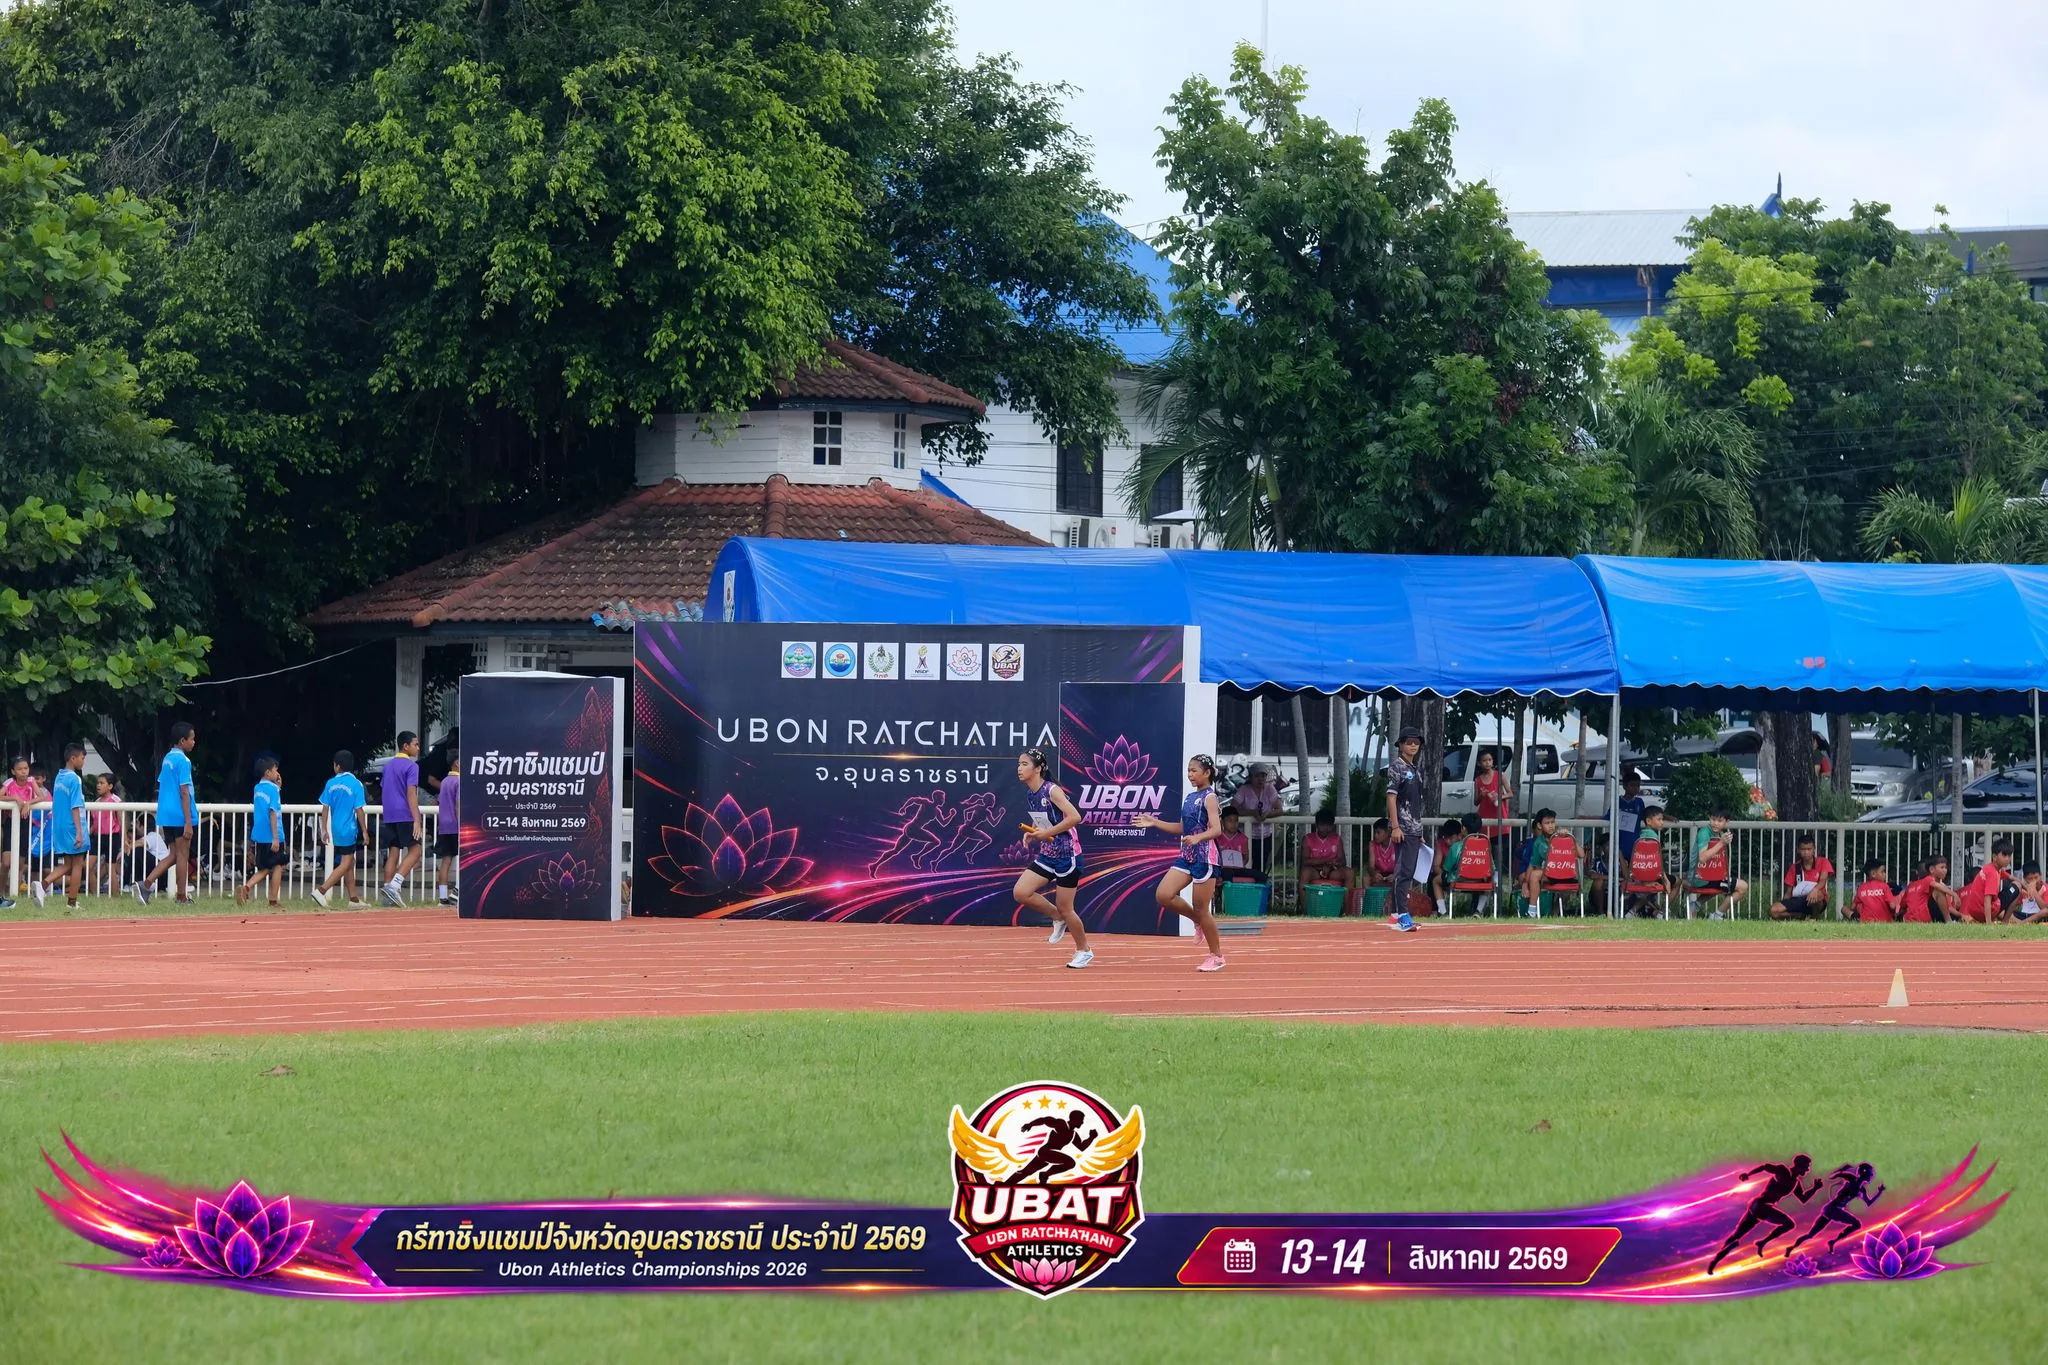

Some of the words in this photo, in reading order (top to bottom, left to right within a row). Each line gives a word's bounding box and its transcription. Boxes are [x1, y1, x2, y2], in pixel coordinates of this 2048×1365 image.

[717, 717, 827, 744] UBON
[470, 750, 606, 776] กรีฑาชิงแชมป์
[815, 763, 989, 789] จ.อุบลราชธานี
[485, 778, 586, 800] จ.อุบลราชธานี
[1078, 784, 1168, 810] UBON
[515, 802, 538, 810] ประจำปี
[1082, 811, 1162, 823] ATHLETS
[521, 816, 558, 828] สิงหาคม
[561, 817, 586, 828] 2569
